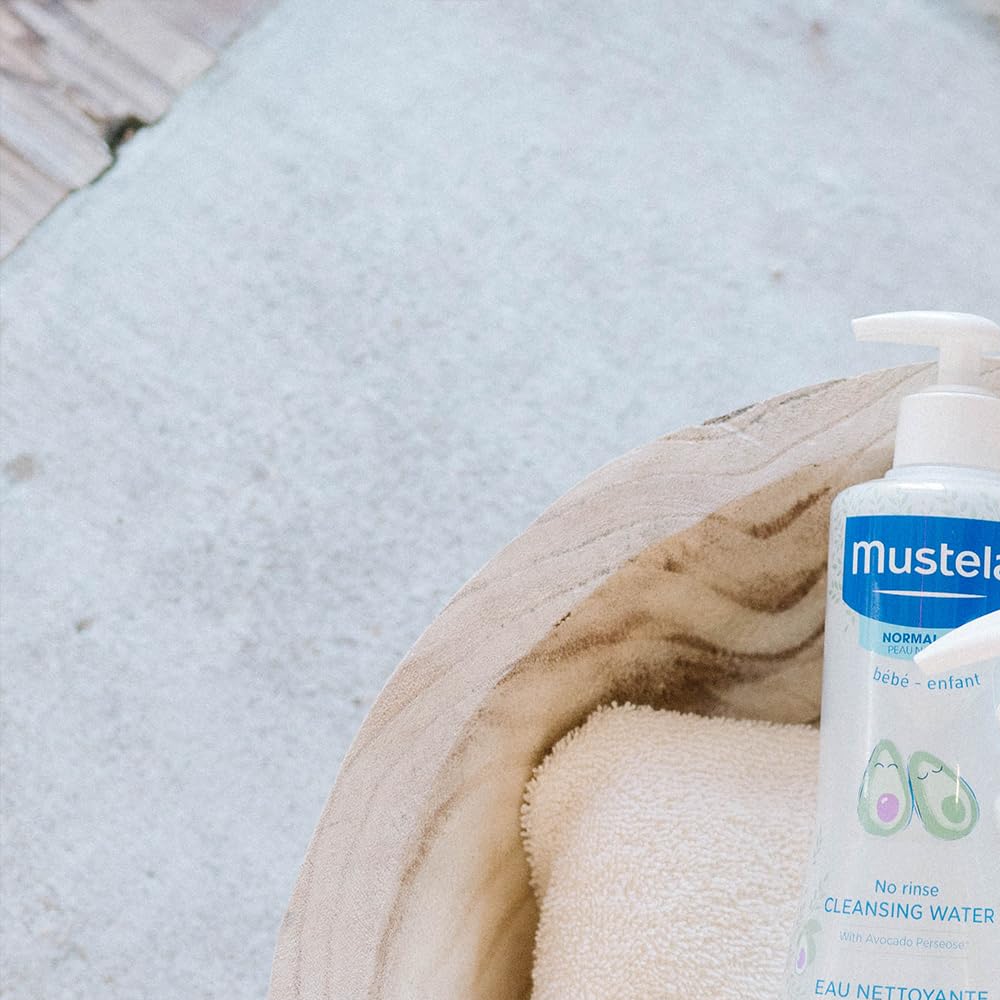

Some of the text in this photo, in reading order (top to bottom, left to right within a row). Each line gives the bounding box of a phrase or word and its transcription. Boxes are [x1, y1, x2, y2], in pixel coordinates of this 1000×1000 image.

[887, 645, 913, 655] PEAU
[873, 667, 909, 688] bébé
[927, 673, 981, 690] enfant
[875, 879, 939, 897] No rinse
[824, 897, 995, 924] CLEANSING WATER
[840, 931, 863, 944] With
[865, 933, 913, 947] Avocado
[815, 979, 850, 998] EAU
